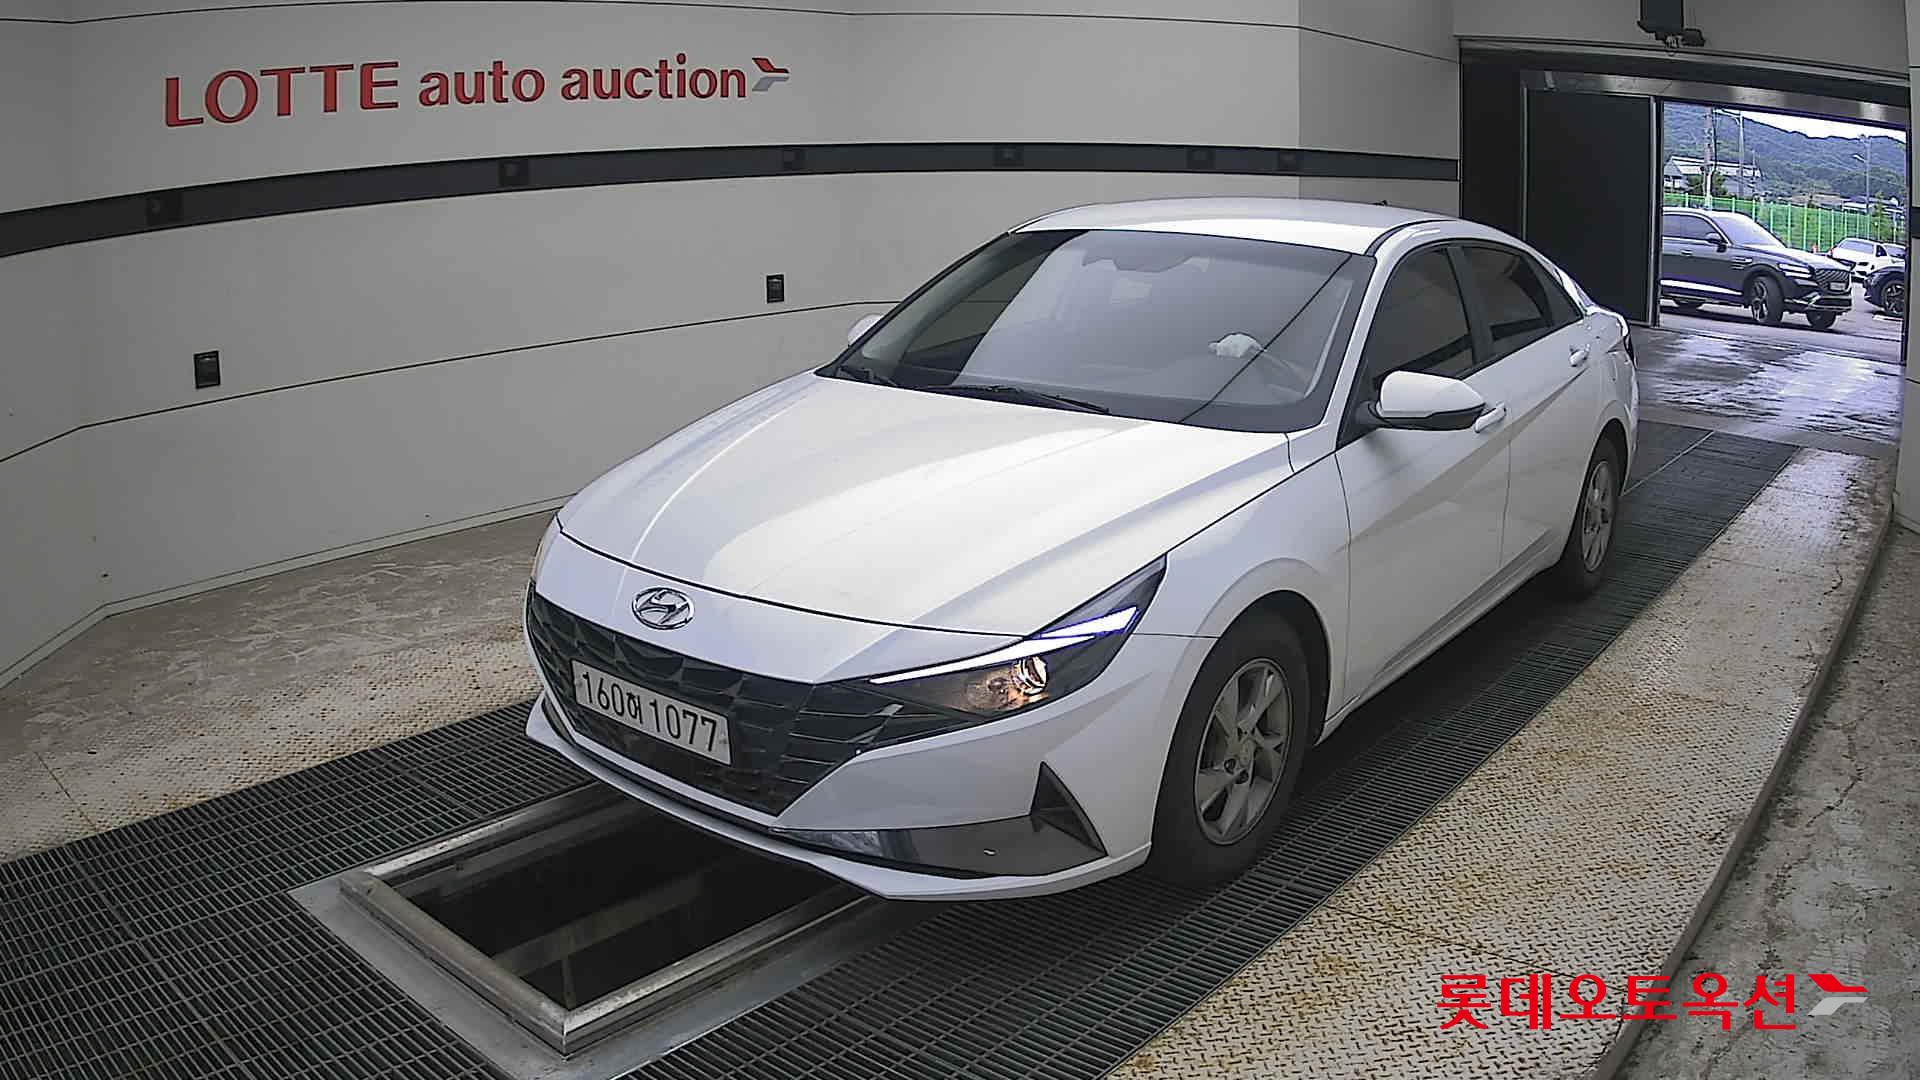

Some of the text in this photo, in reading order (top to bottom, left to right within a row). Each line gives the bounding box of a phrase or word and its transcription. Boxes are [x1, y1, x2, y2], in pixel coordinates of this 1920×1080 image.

[165, 53, 747, 127] LOTTE auto auction
[649, 699, 717, 752] 1077
